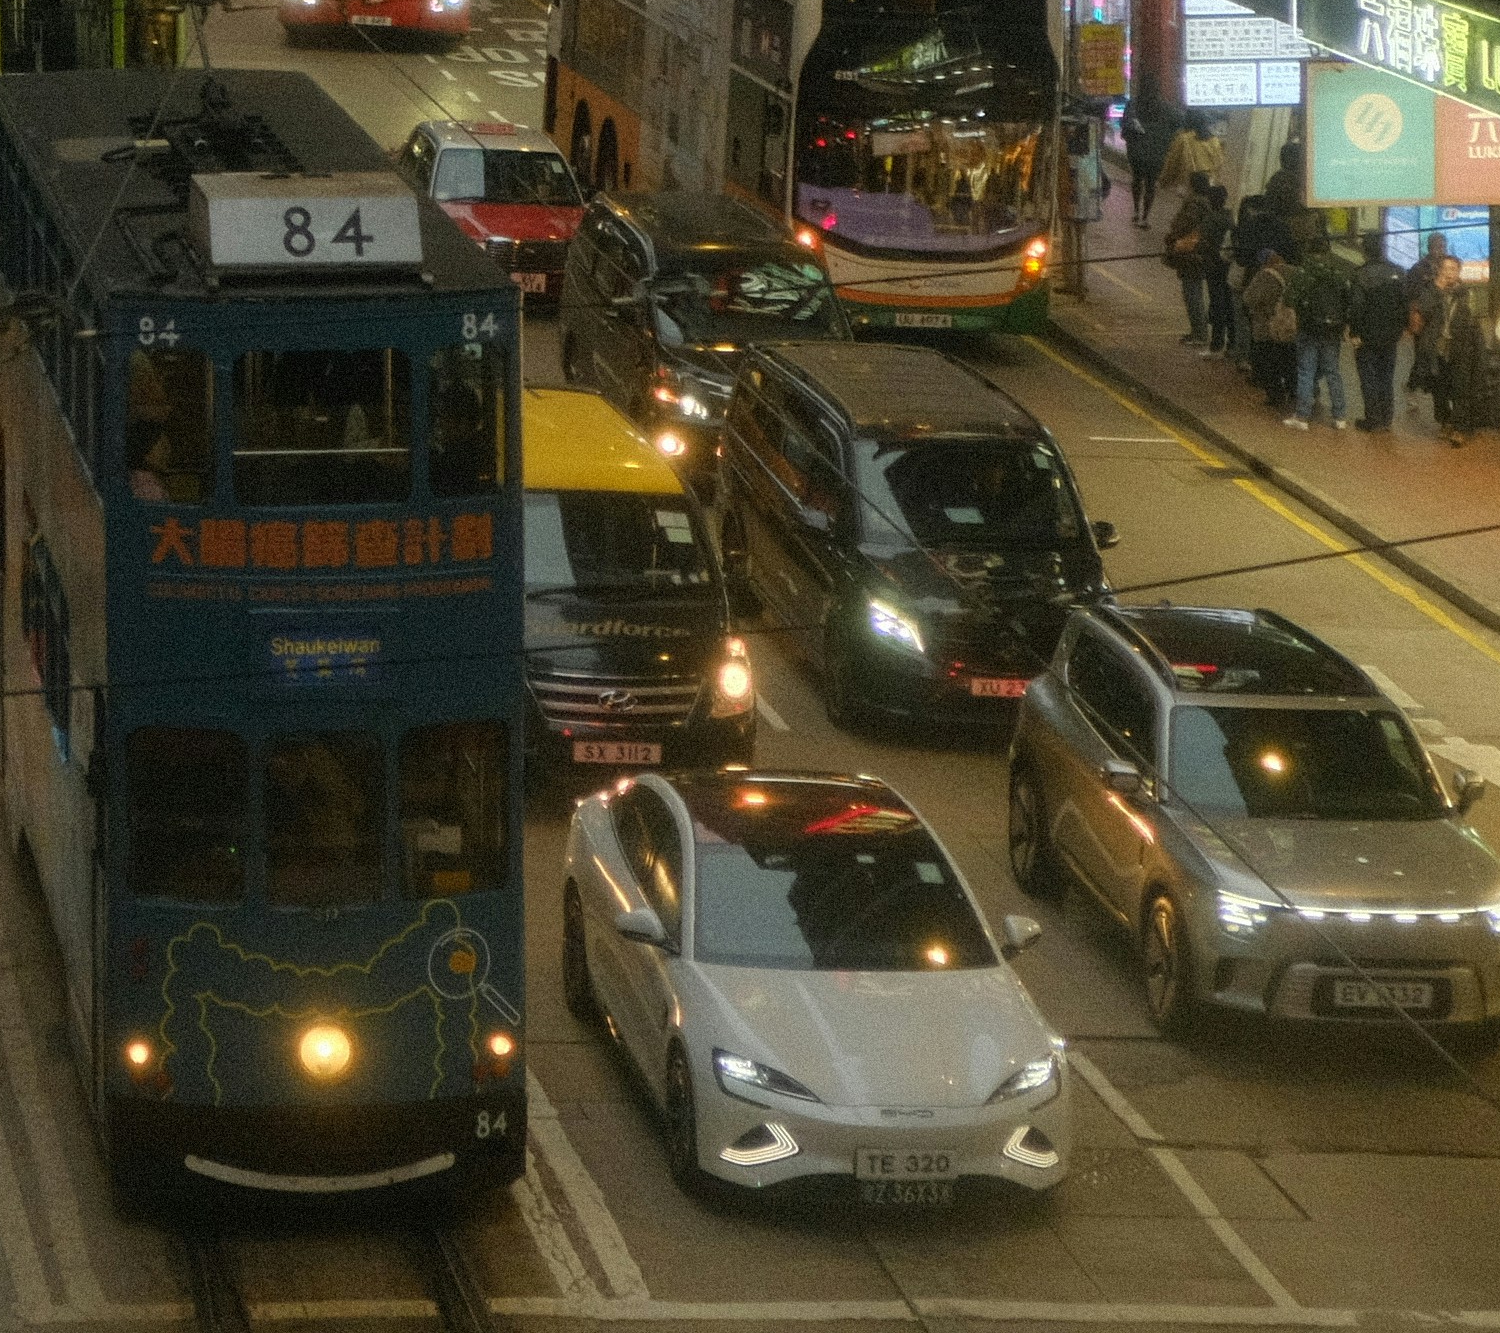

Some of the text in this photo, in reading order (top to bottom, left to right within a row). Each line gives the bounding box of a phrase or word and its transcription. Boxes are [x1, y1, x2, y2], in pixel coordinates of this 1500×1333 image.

[282, 206, 373, 258] 84
[138, 315, 180, 347] 84
[461, 311, 500, 340] 84
[527, 618, 692, 641] uardforce
[270, 636, 381, 656] Shaukeiwan
[584, 748, 652, 762] SX 3112
[476, 1110, 508, 1139] 84
[868, 1154, 950, 1174] TE 320
